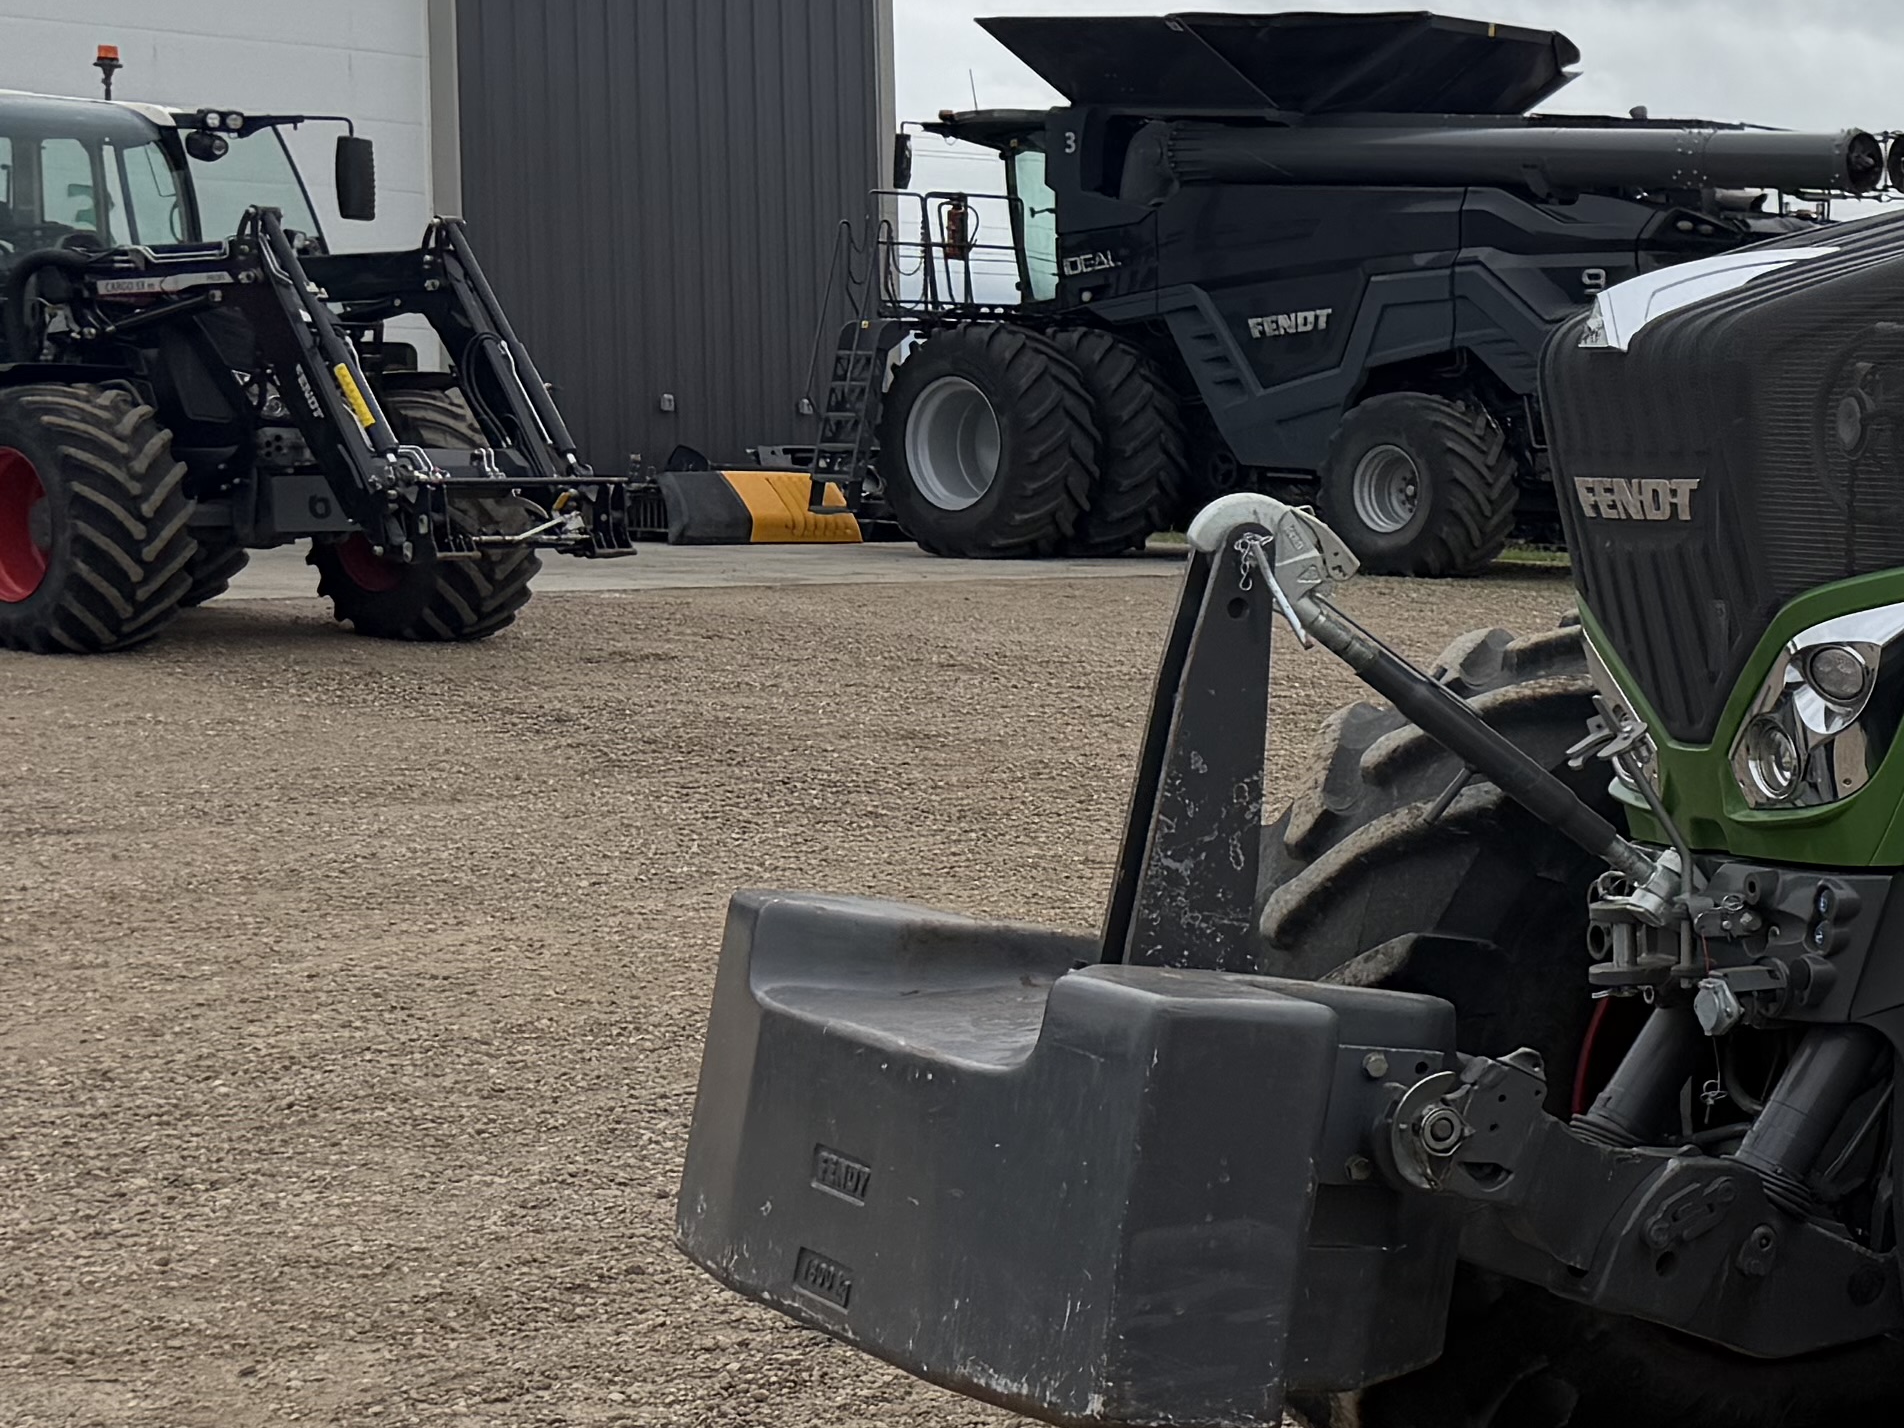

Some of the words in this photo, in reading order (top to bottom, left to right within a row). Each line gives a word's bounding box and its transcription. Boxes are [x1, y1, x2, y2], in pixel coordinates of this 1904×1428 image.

[1065, 131, 1076, 153] 3
[1063, 250, 1122, 276] IDEAL
[1247, 308, 1332, 339] FENDT
[1573, 476, 1700, 521] FENDT
